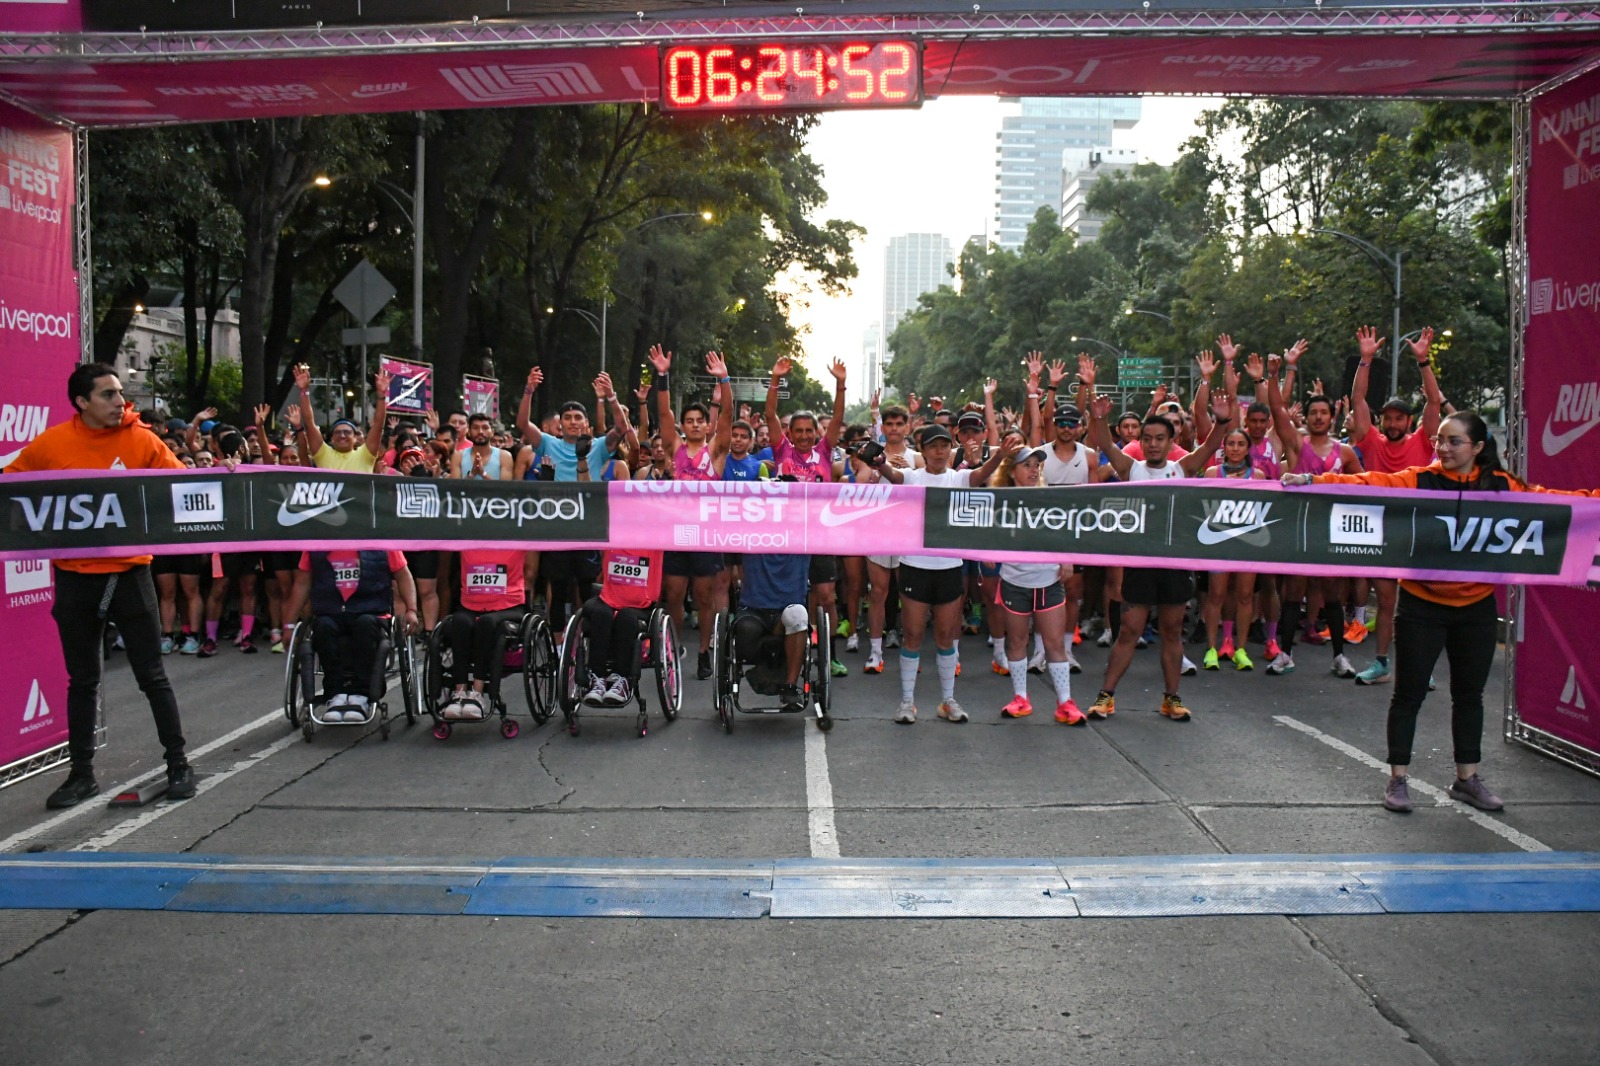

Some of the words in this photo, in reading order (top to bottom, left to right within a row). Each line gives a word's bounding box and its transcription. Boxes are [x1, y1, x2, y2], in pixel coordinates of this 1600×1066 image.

[1161, 55, 1322, 64] RUNNING
[669, 44, 910, 104] 06:24:52
[360, 82, 408, 93] RUN
[8, 159, 60, 200] FEST
[12, 193, 61, 225] Liverpool
[0, 299, 71, 341] iverpool
[0, 404, 50, 442] RUN
[183, 493, 215, 511] JBL
[289, 482, 345, 505] RUN
[835, 485, 893, 508] RUN
[10, 493, 127, 532] VISA
[446, 491, 585, 527] Liverpool
[699, 497, 788, 522] FEST
[1001, 500, 1146, 539] Liverpool
[1212, 500, 1273, 525] RUN
[179, 523, 225, 532] HARMAN
[1342, 515, 1374, 533] JBL
[1435, 515, 1545, 556] VISA
[704, 529, 789, 548] Liverpool
[1335, 546, 1383, 555] HARMAN
[472, 574, 500, 585] 2187
[613, 564, 642, 577] 2189
[10, 590, 52, 608] HARMAN
